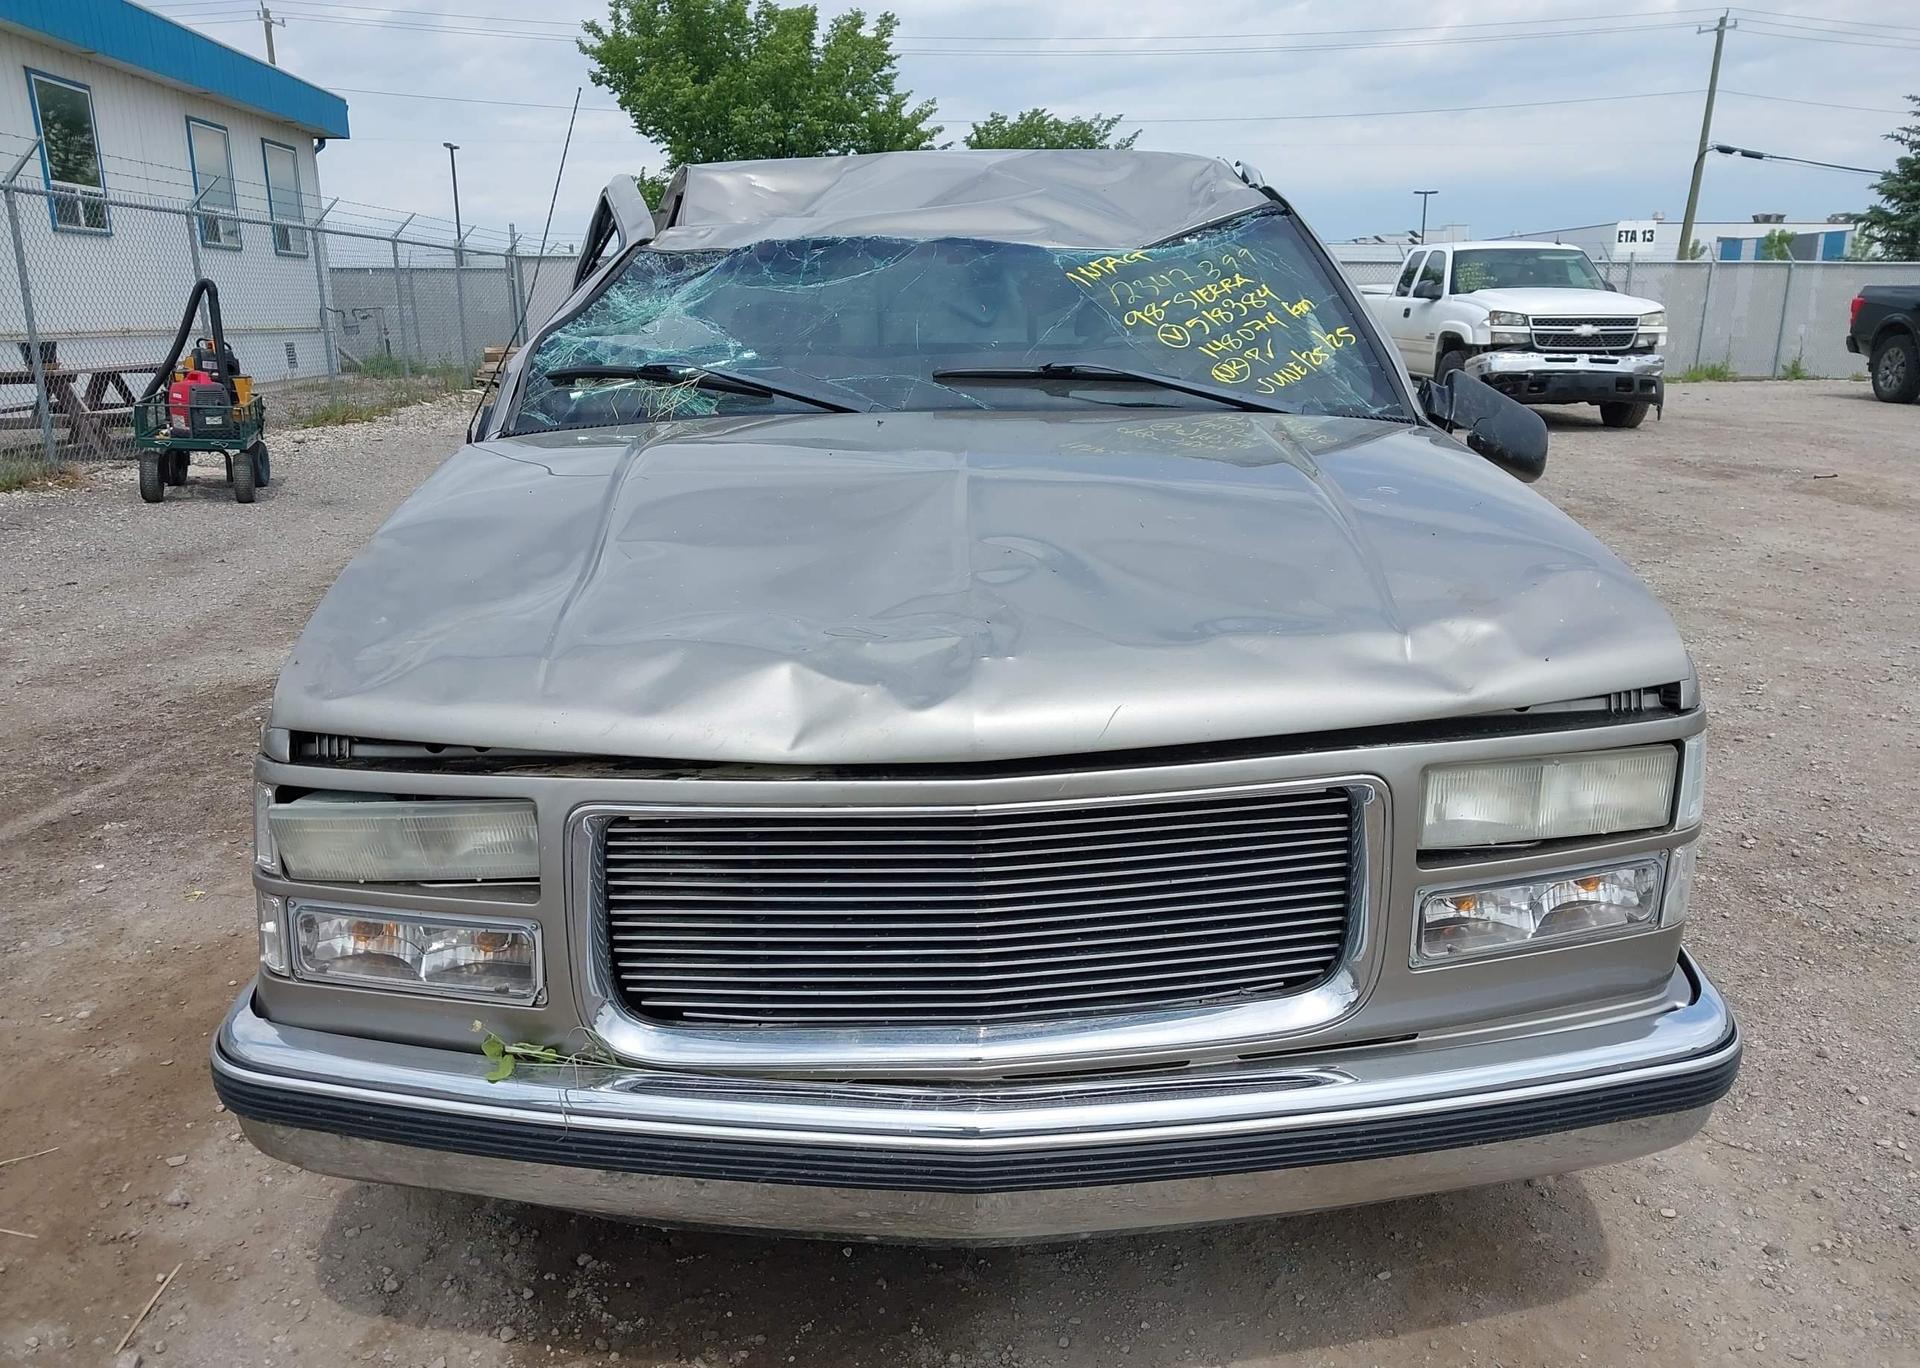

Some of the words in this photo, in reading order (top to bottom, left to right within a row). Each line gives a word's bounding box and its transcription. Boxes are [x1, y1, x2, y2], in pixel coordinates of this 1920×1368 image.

[1617, 229, 1637, 243] ETA
[1642, 229, 1655, 243] 13
[1066, 250, 1153, 288] INTACT
[1185, 284, 1281, 334] 518384
[1199, 312, 1289, 359] 148074
